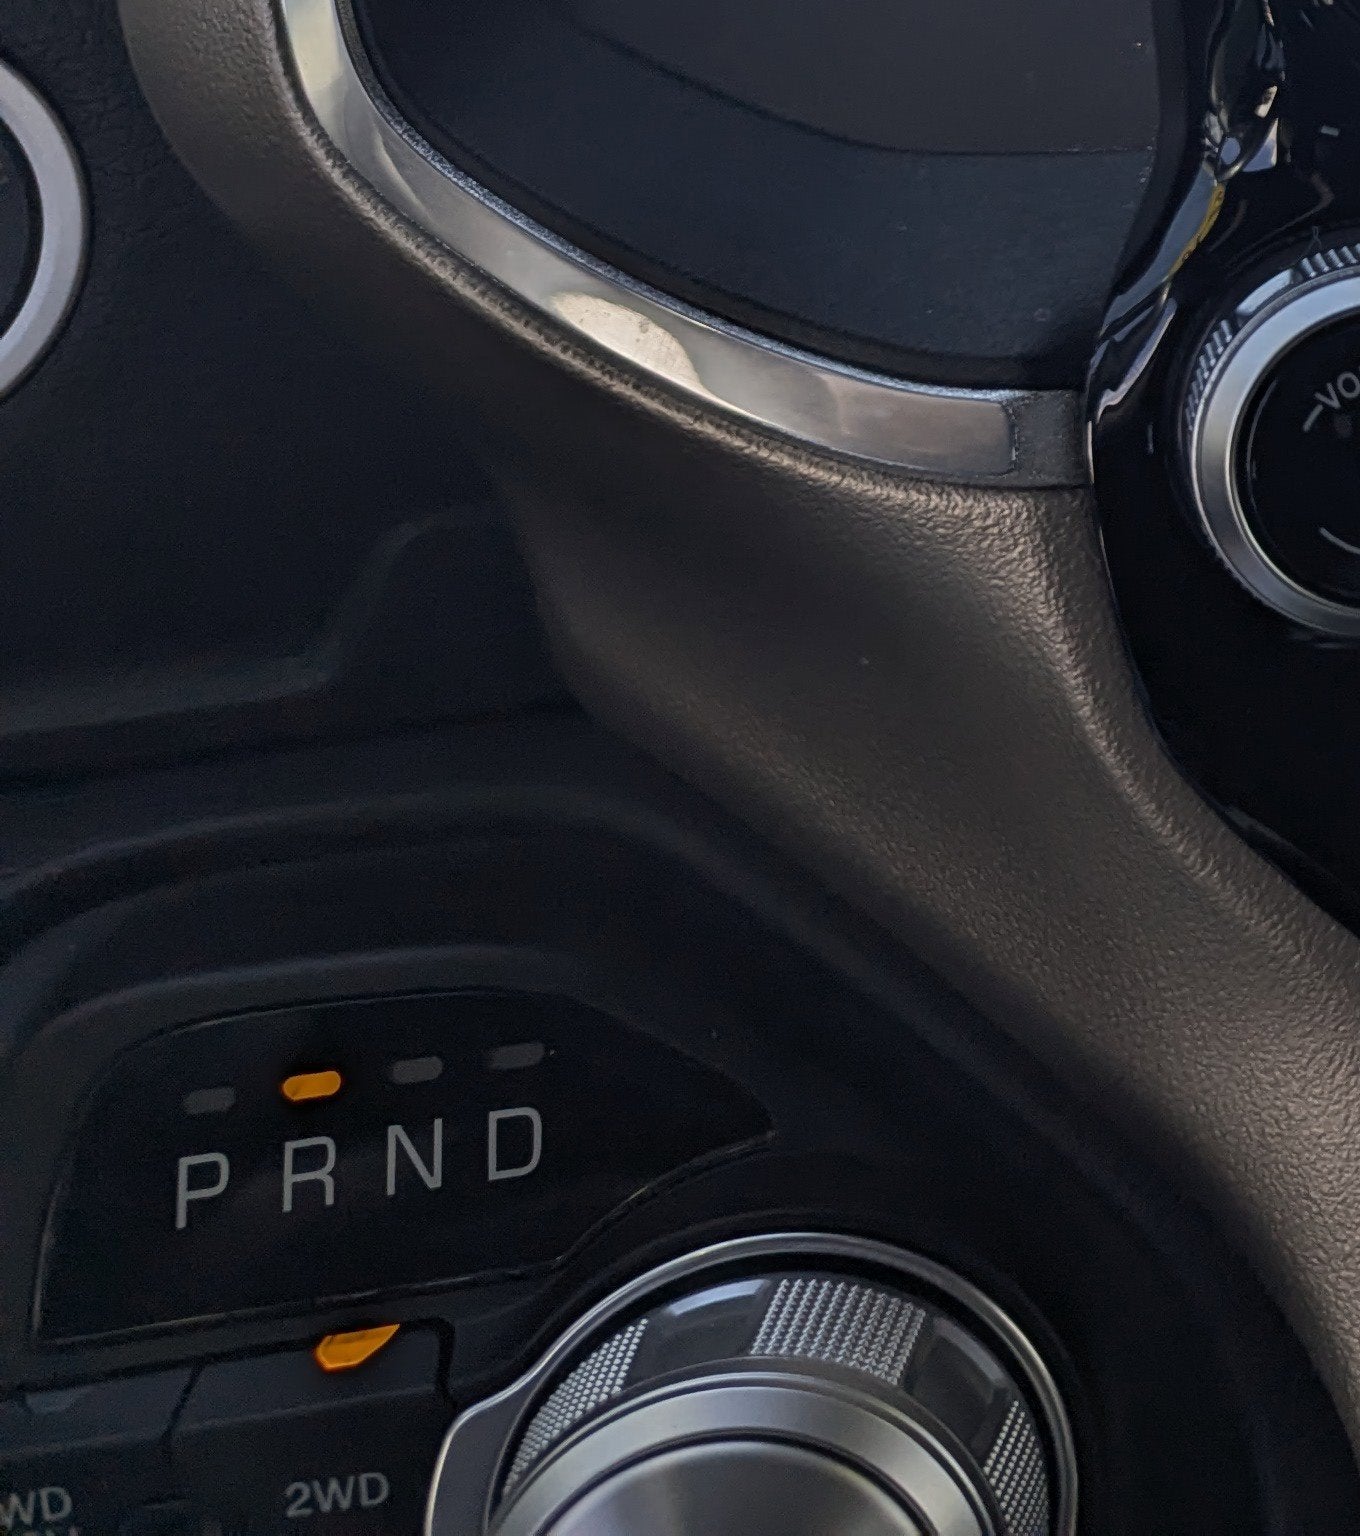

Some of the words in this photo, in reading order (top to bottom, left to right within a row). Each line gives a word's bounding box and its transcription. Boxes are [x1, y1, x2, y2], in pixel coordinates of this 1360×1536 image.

[175, 1152, 230, 1230] P
[282, 1135, 336, 1213] R
[386, 1117, 443, 1196] N
[488, 1106, 543, 1181] D
[0, 1486, 73, 1531] WD
[284, 1471, 389, 1518] 2WD
